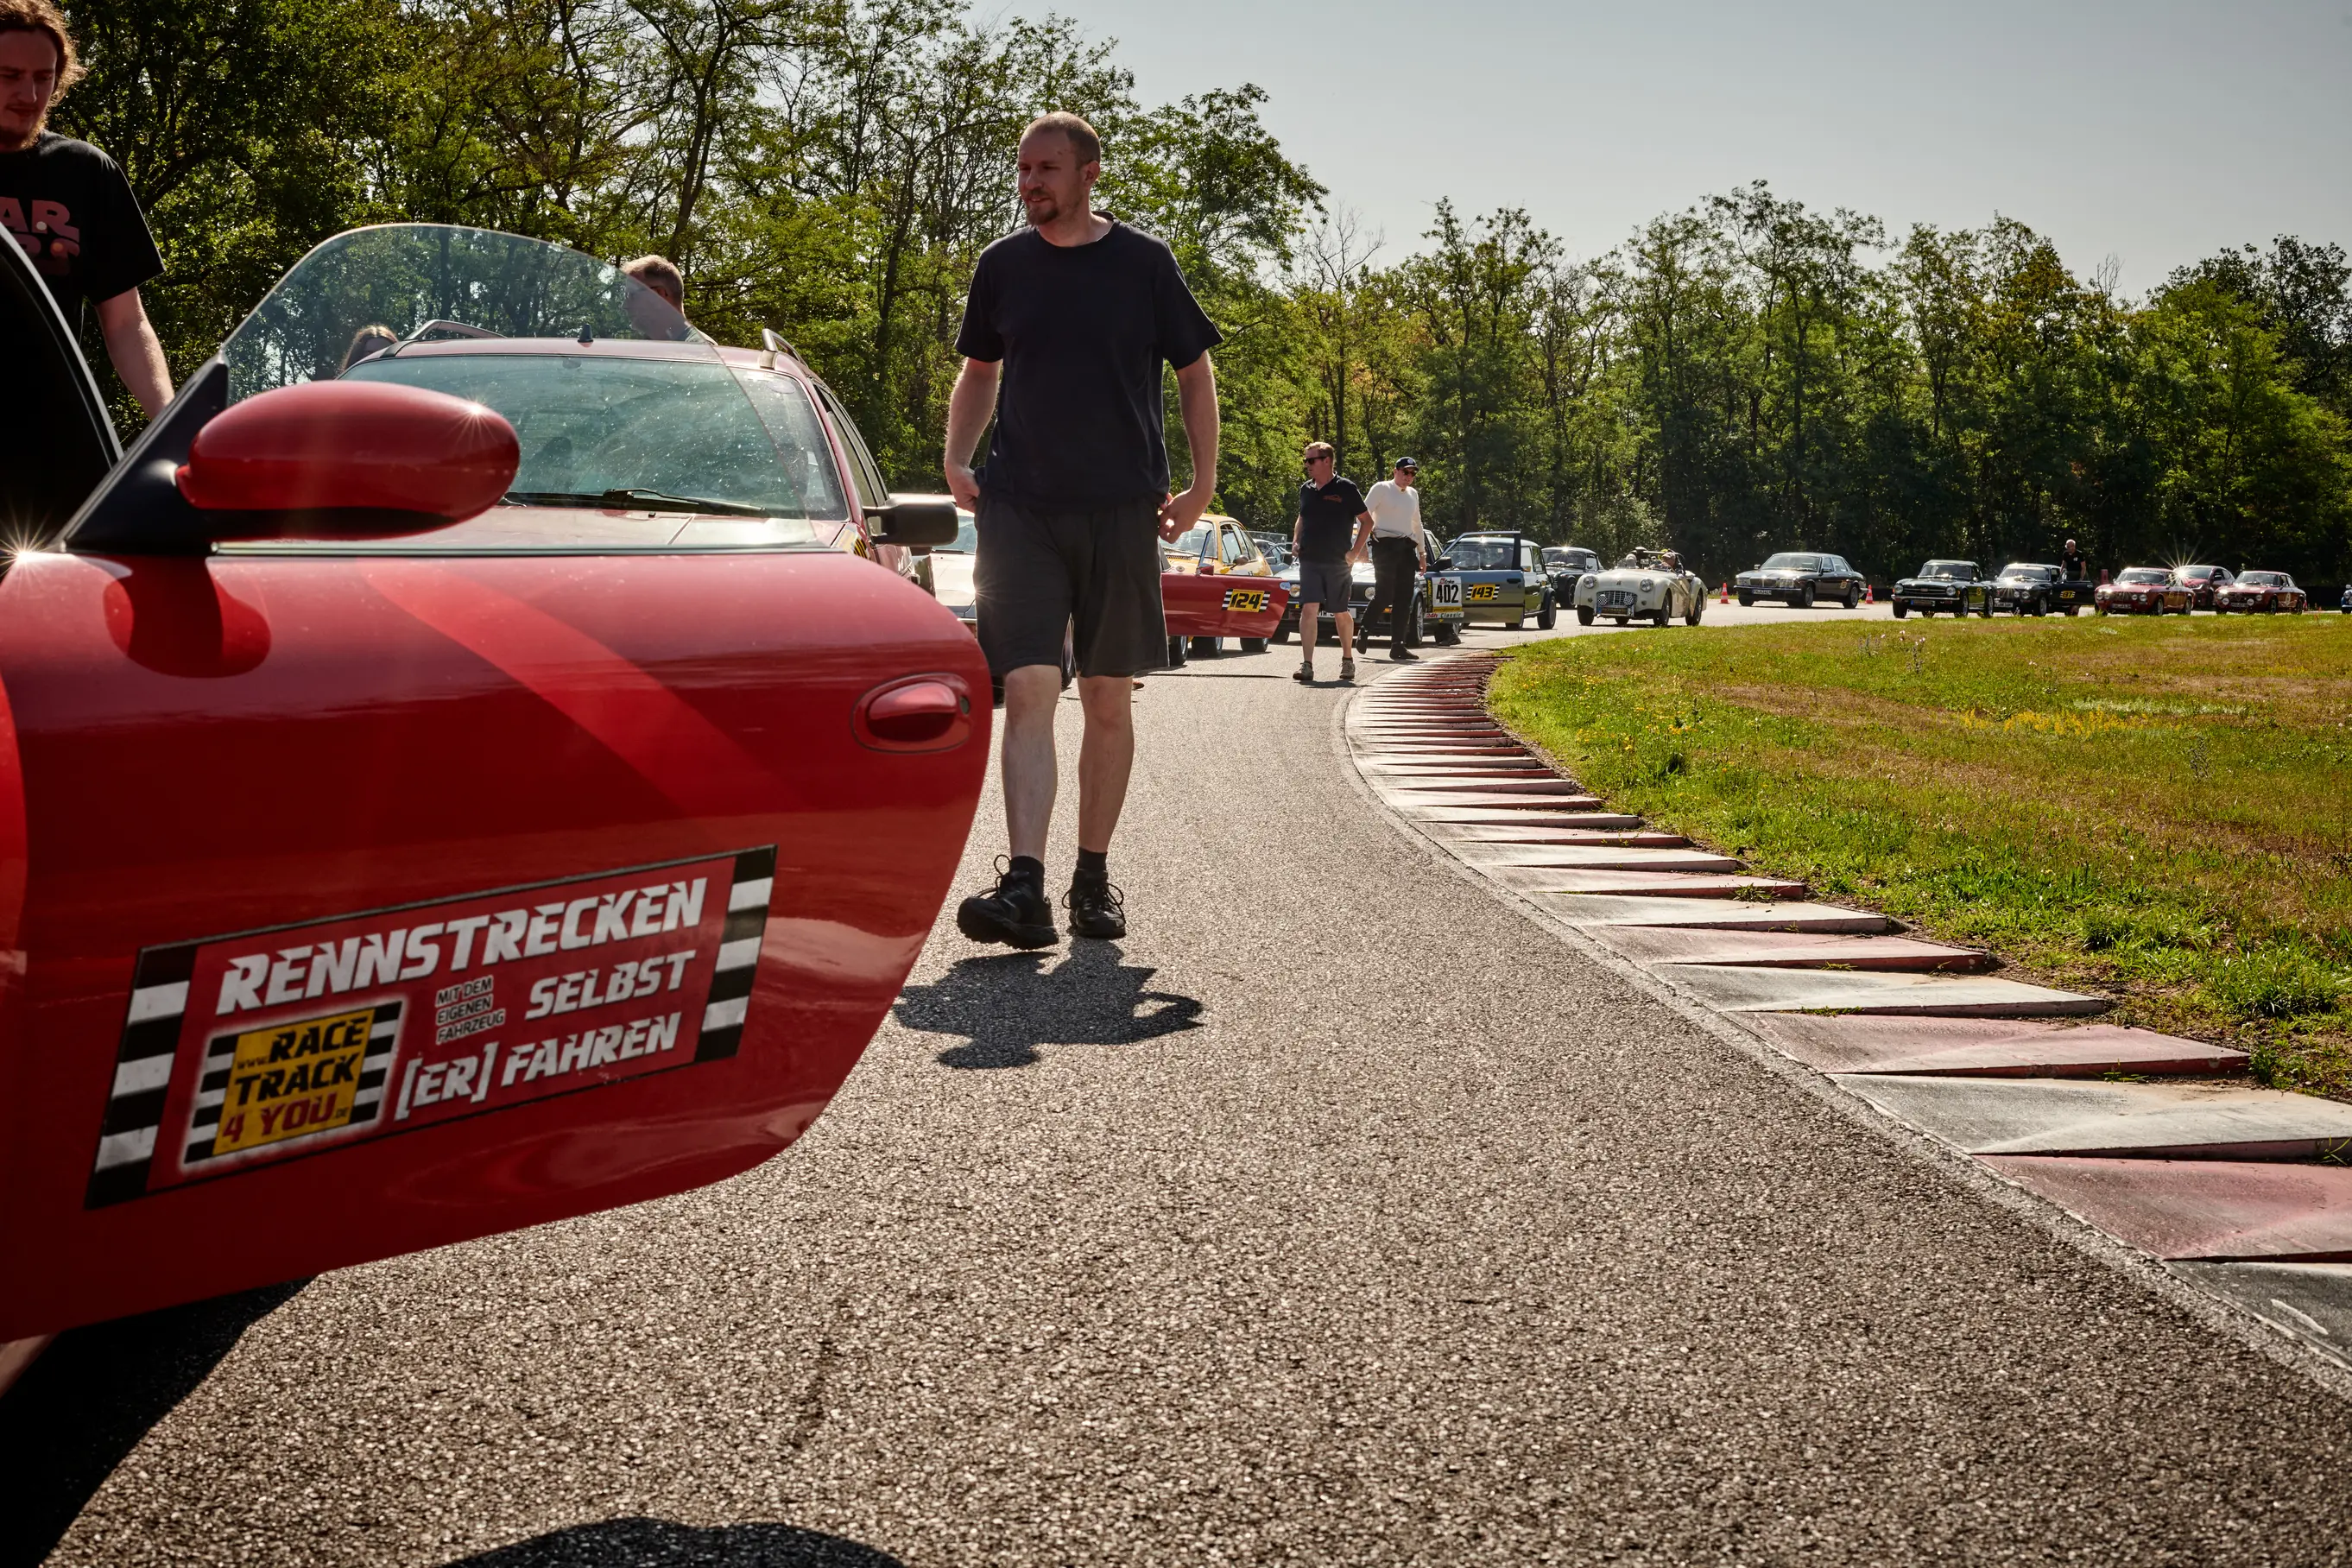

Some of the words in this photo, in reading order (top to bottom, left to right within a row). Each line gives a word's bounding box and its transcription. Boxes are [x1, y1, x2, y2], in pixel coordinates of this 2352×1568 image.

[1230, 593, 1261, 610] 124
[1436, 585, 1459, 603] 402
[1471, 587, 1494, 598] 143
[216, 877, 707, 1015] RENNSTRECKEN
[437, 985, 461, 1005] MIT
[464, 977, 492, 997] DEM
[524, 950, 696, 1021] SELBST
[437, 996, 492, 1024] EIGENEN
[437, 1009, 504, 1043] FAHRZEUG
[234, 1052, 360, 1107] TRACK
[394, 1041, 499, 1121] [ER]
[500, 1012, 681, 1088] FAHREN
[222, 1111, 245, 1143] 4
